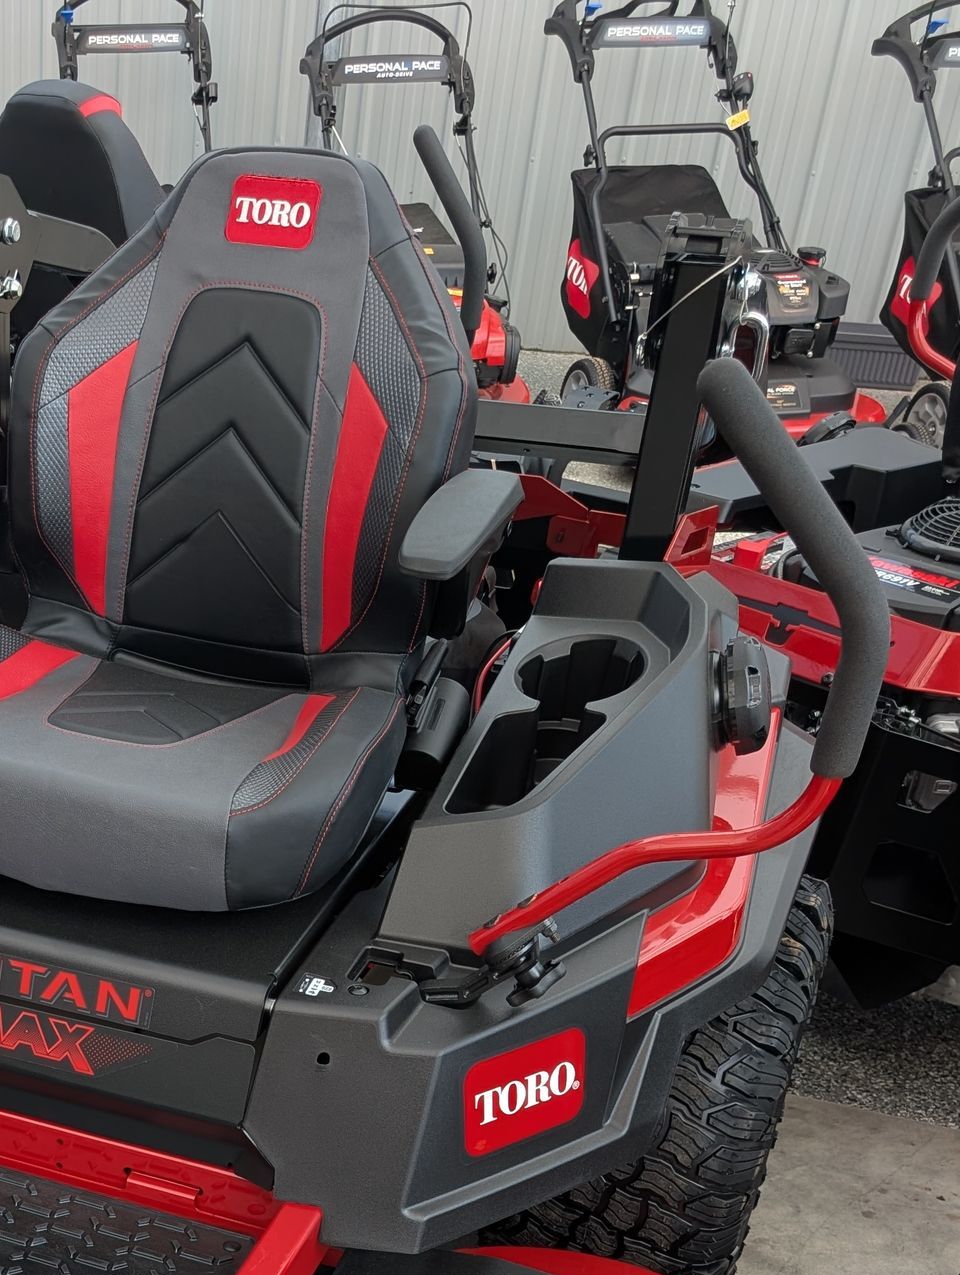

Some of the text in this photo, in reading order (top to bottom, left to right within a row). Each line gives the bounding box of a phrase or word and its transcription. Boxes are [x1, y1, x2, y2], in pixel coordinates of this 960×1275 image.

[606, 25, 704, 37] PERSONAL PACE
[88, 33, 179, 45] PERSONAL PACE
[344, 60, 441, 74] PERSONAL PACE
[235, 196, 311, 228] TORO
[474, 1061, 577, 1126] TORO
